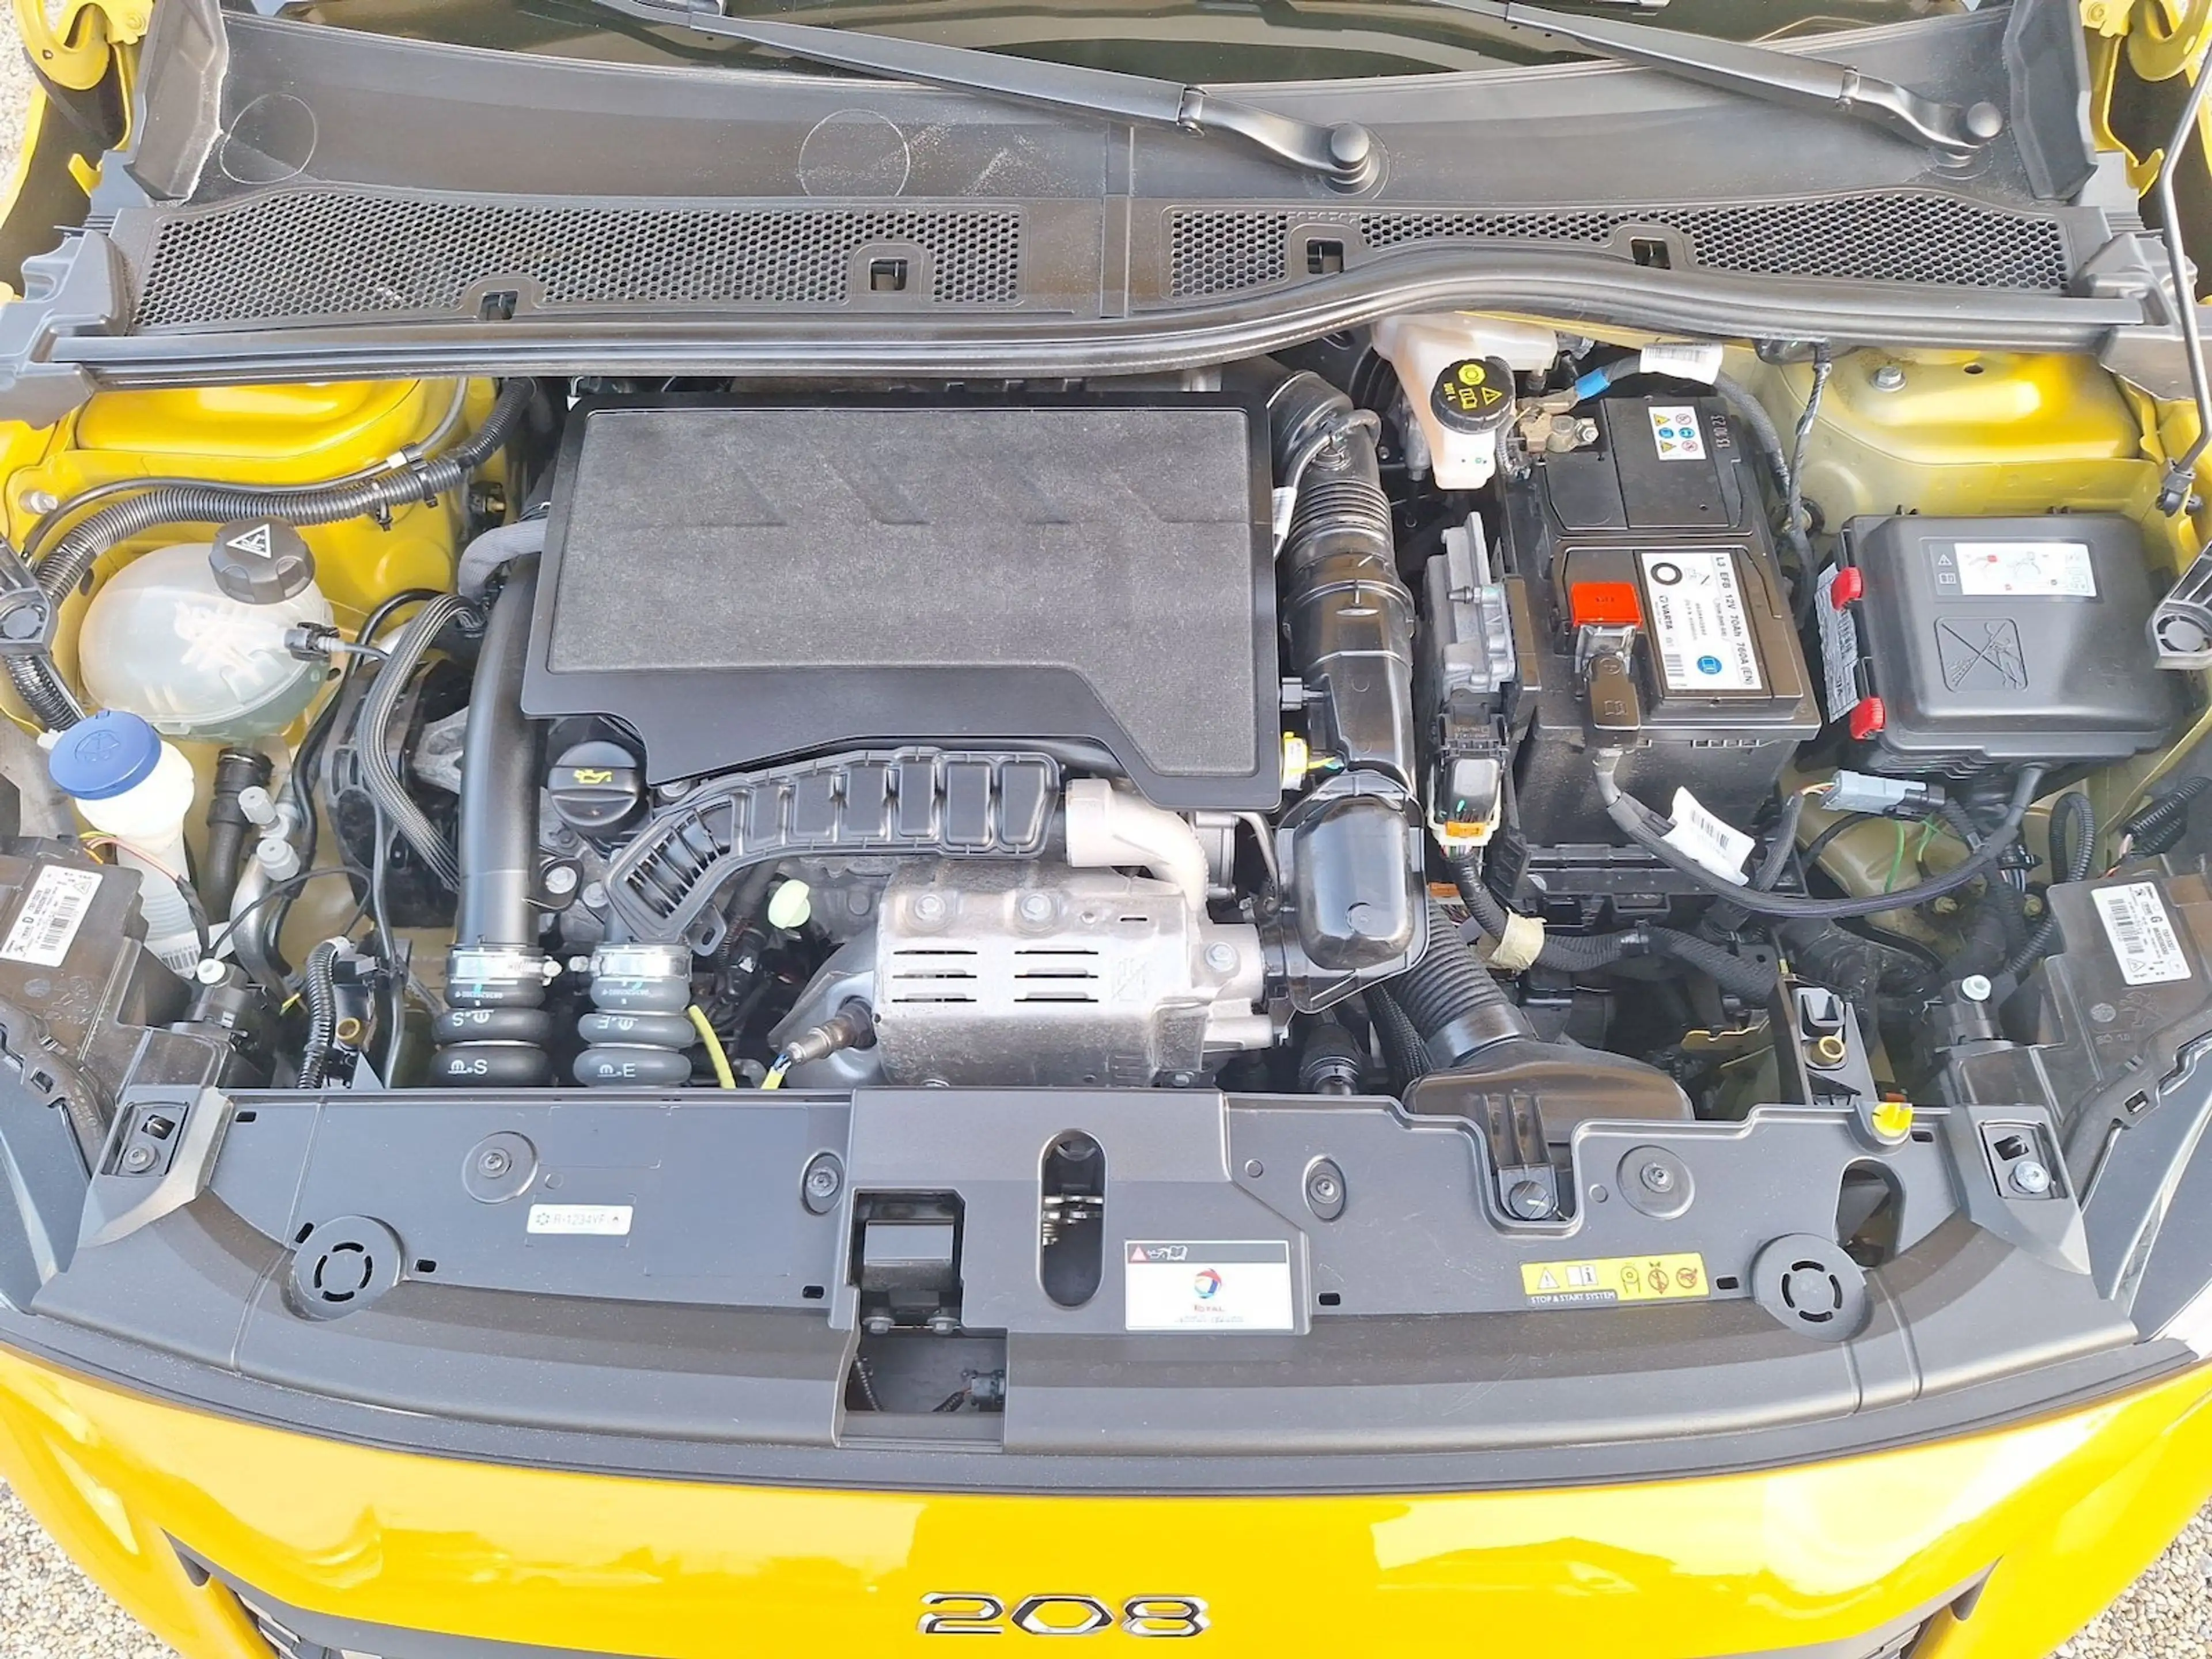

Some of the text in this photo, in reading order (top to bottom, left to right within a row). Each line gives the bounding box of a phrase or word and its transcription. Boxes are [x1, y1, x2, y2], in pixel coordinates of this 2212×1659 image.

[1715, 556, 1726, 567] L3
[1725, 594, 1736, 609] 12V
[1661, 603, 1673, 630] VARTA
[1730, 614, 1742, 637] 70Ah
[1531, 1295, 1552, 1304] STOP
[1559, 1293, 1584, 1302] START
[1585, 1290, 1616, 1301] SYSTEM
[1194, 1304, 1225, 1312] TOTAL
[916, 1591, 1210, 1638] 208
